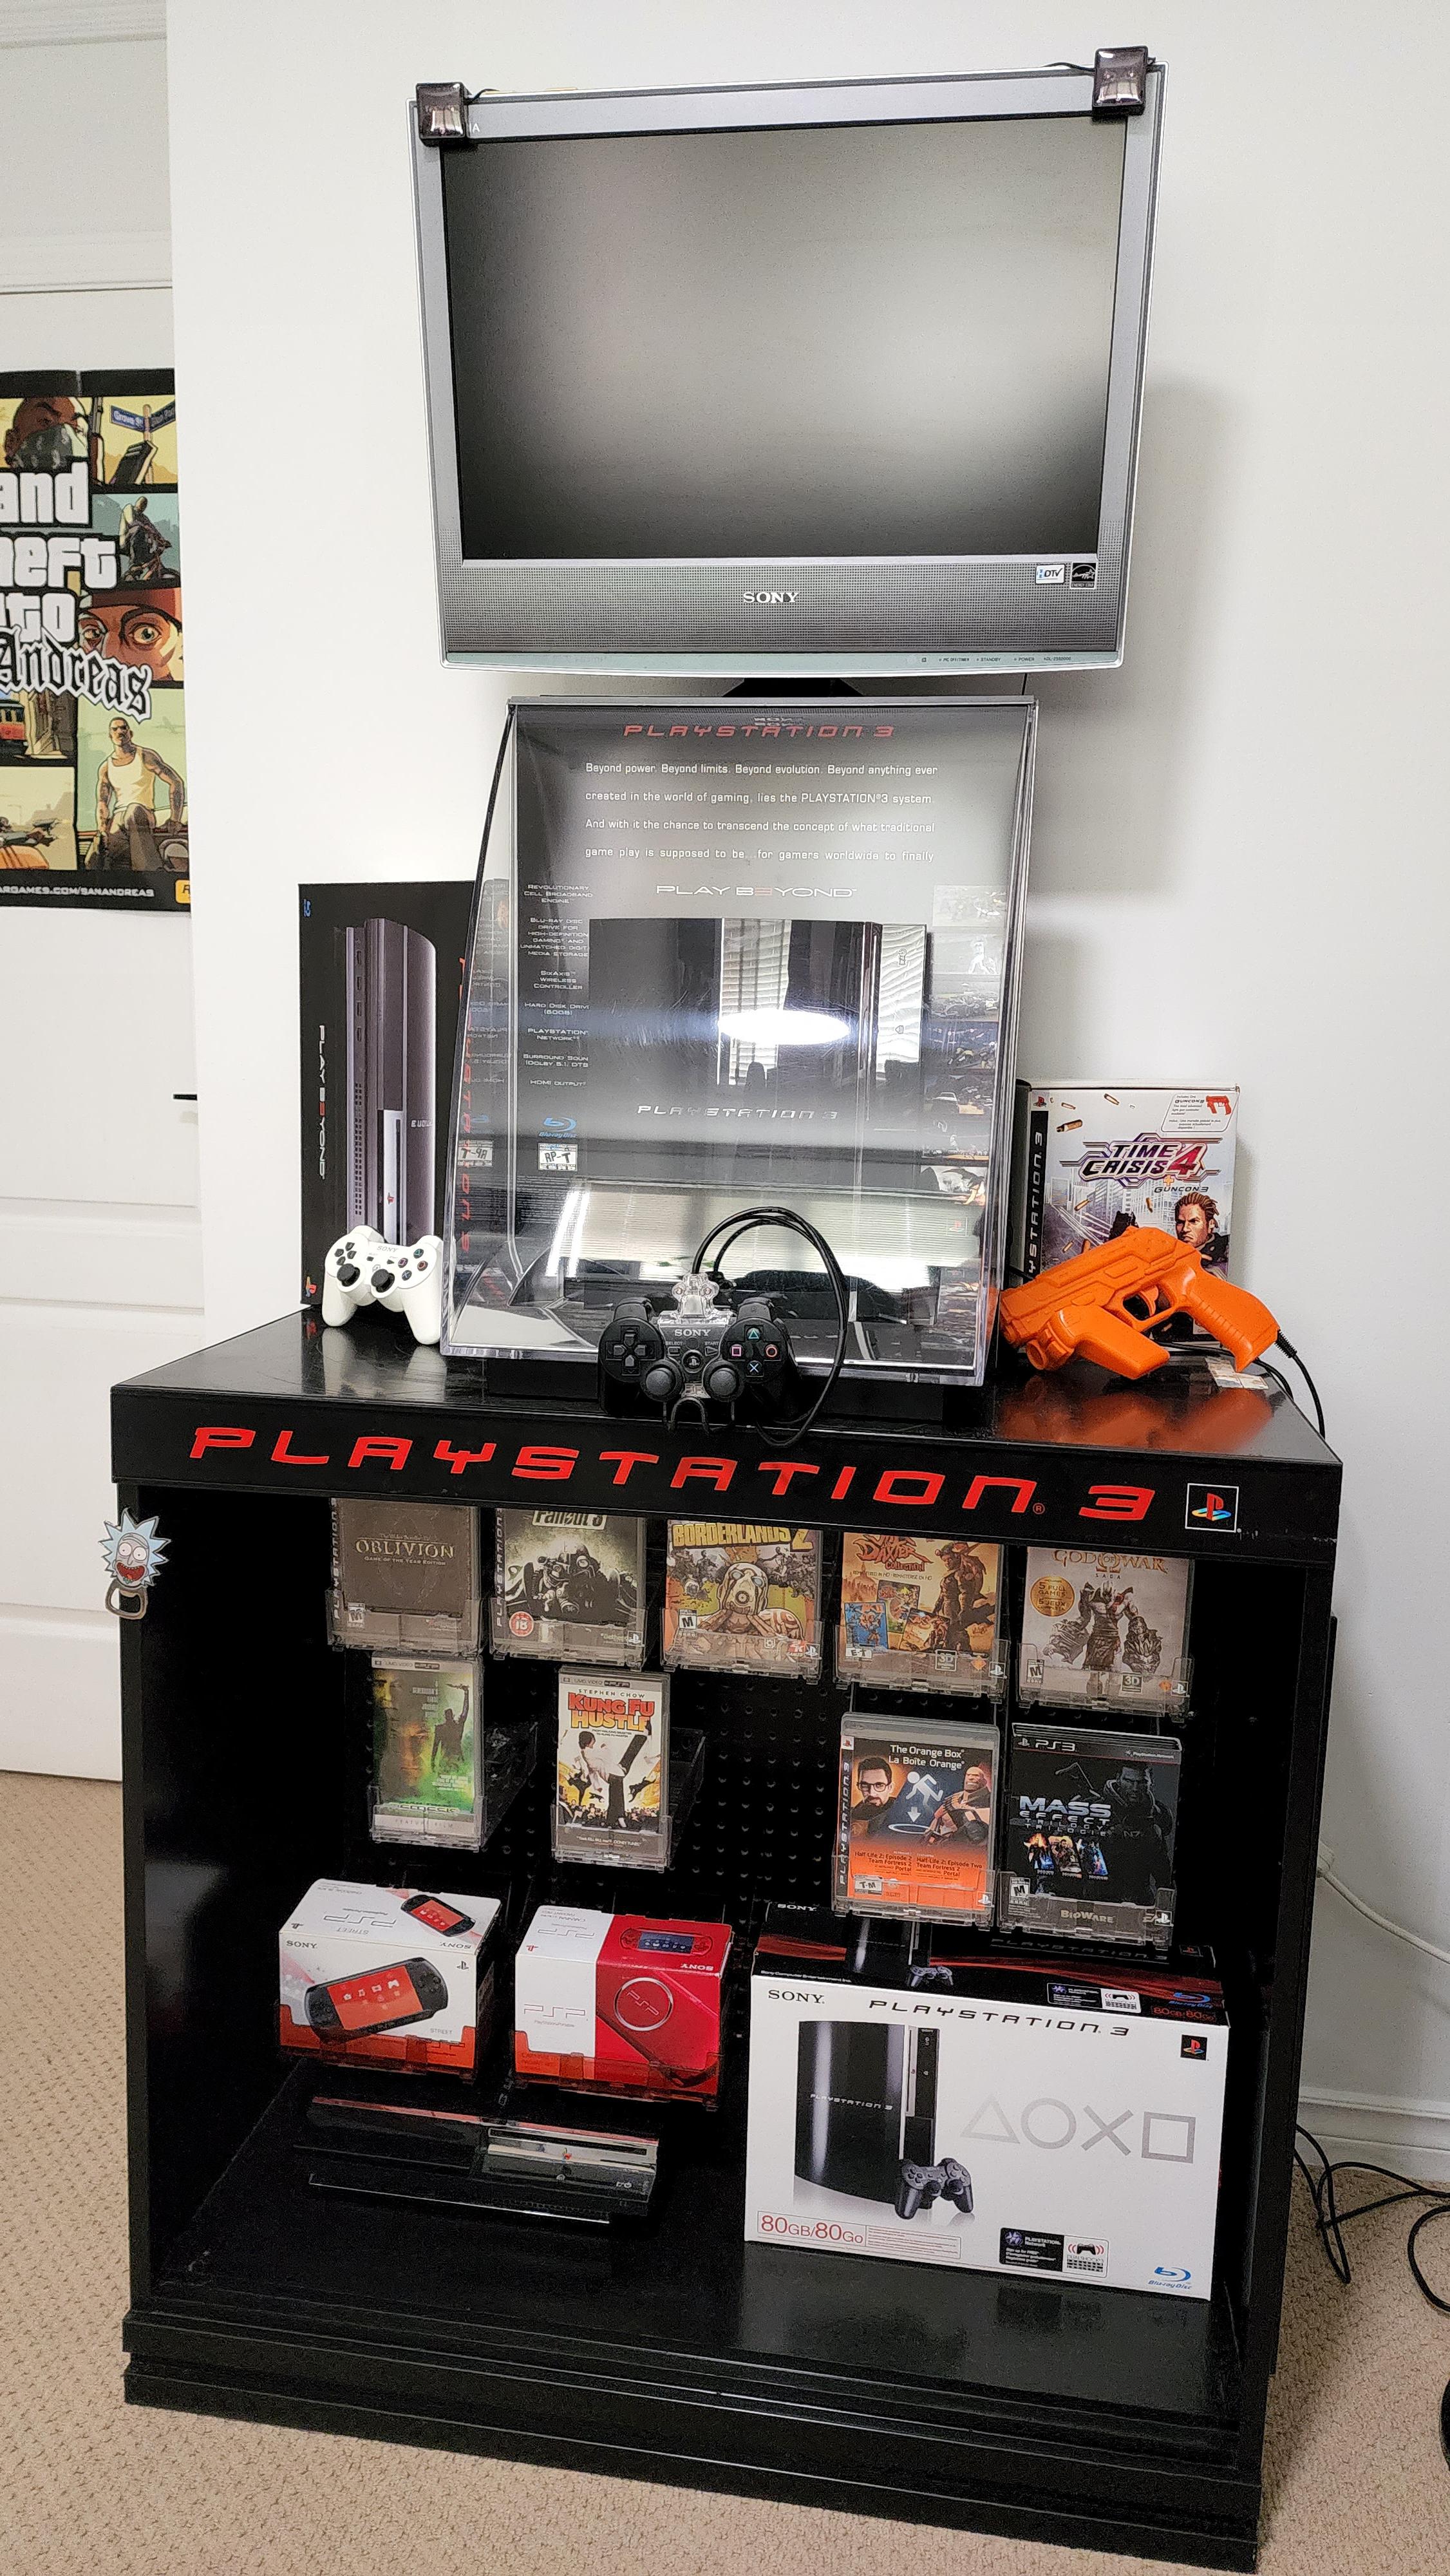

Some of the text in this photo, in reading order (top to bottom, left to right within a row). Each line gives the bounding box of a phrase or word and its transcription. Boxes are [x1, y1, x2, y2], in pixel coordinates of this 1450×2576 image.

[742, 591, 800, 603] SONY
[623, 724, 895, 738] PLAYSTATION 3
[586, 762, 621, 773] Beyond
[661, 764, 697, 774] Beyond
[735, 764, 771, 775] Beyond
[828, 765, 864, 775] Beyond
[869, 765, 911, 777] anything
[915, 766, 937, 775] ever
[585, 791, 626, 800] created
[630, 792, 639, 800] in
[643, 792, 660, 801] the
[664, 792, 693, 801] world
[697, 793, 707, 802] of
[758, 793, 776, 802] lies
[780, 793, 797, 802] the
[585, 819, 605, 829] And
[608, 820, 629, 829] with
[632, 820, 640, 829] it
[643, 820, 659, 829] the
[663, 820, 700, 829] chance
[717, 821, 769, 831] transcend
[773, 822, 789, 831] the
[793, 822, 834, 833] concept
[838, 822, 849, 831] of
[851, 823, 878, 832] what
[881, 823, 935, 833] traditional
[585, 848, 934, 863] game play is supposed to for gamers worldwide to finally
[656, 886, 731, 896] PLAY
[637, 1106, 838, 1120] PLAYSTATION 3
[544, 1151, 571, 1164] RP-T
[1112, 1144, 1204, 1175] TIME 4
[1082, 1160, 1169, 1176] CRISIS
[673, 1329, 711, 1337] SONY
[189, 1426, 1156, 1521] PLAYSTATION 3
[672, 1522, 791, 1546] BORDERLANDS
[355, 1539, 455, 1558] OBLIVION
[1053, 1549, 1169, 1574] GOD OF WAR
[515, 1618, 528, 1630] 18
[682, 1616, 693, 1627] M
[938, 1653, 954, 1663] 3D
[1124, 1676, 1139, 1686] 3D
[568, 1692, 655, 1716] KUNG FU
[570, 1709, 651, 1732] HUSTLE
[890, 1745, 962, 1759] The Orange Box
[1035, 1739, 1077, 1752] PS3
[903, 1756, 927, 1766] Boîte
[929, 1759, 962, 1771] Orange
[1019, 1795, 1111, 1819] MASS
[1019, 1810, 1111, 1826] EFFECT
[1024, 1818, 1104, 1831] TRILOGY
[1024, 1823, 1107, 1837] TRILOGIE
[885, 1853, 907, 1862] Episode
[287, 1940, 317, 1949] SONY
[768, 1989, 825, 2004] SONY
[523, 2003, 586, 2019] PSP
[869, 2000, 1129, 2036] PLAYSTATION 3
[810, 2093, 881, 2110] PLAYSTATION
[760, 2215, 863, 2244] 80GB/80Go
[1148, 2280, 1175, 2289] Blu-ray
